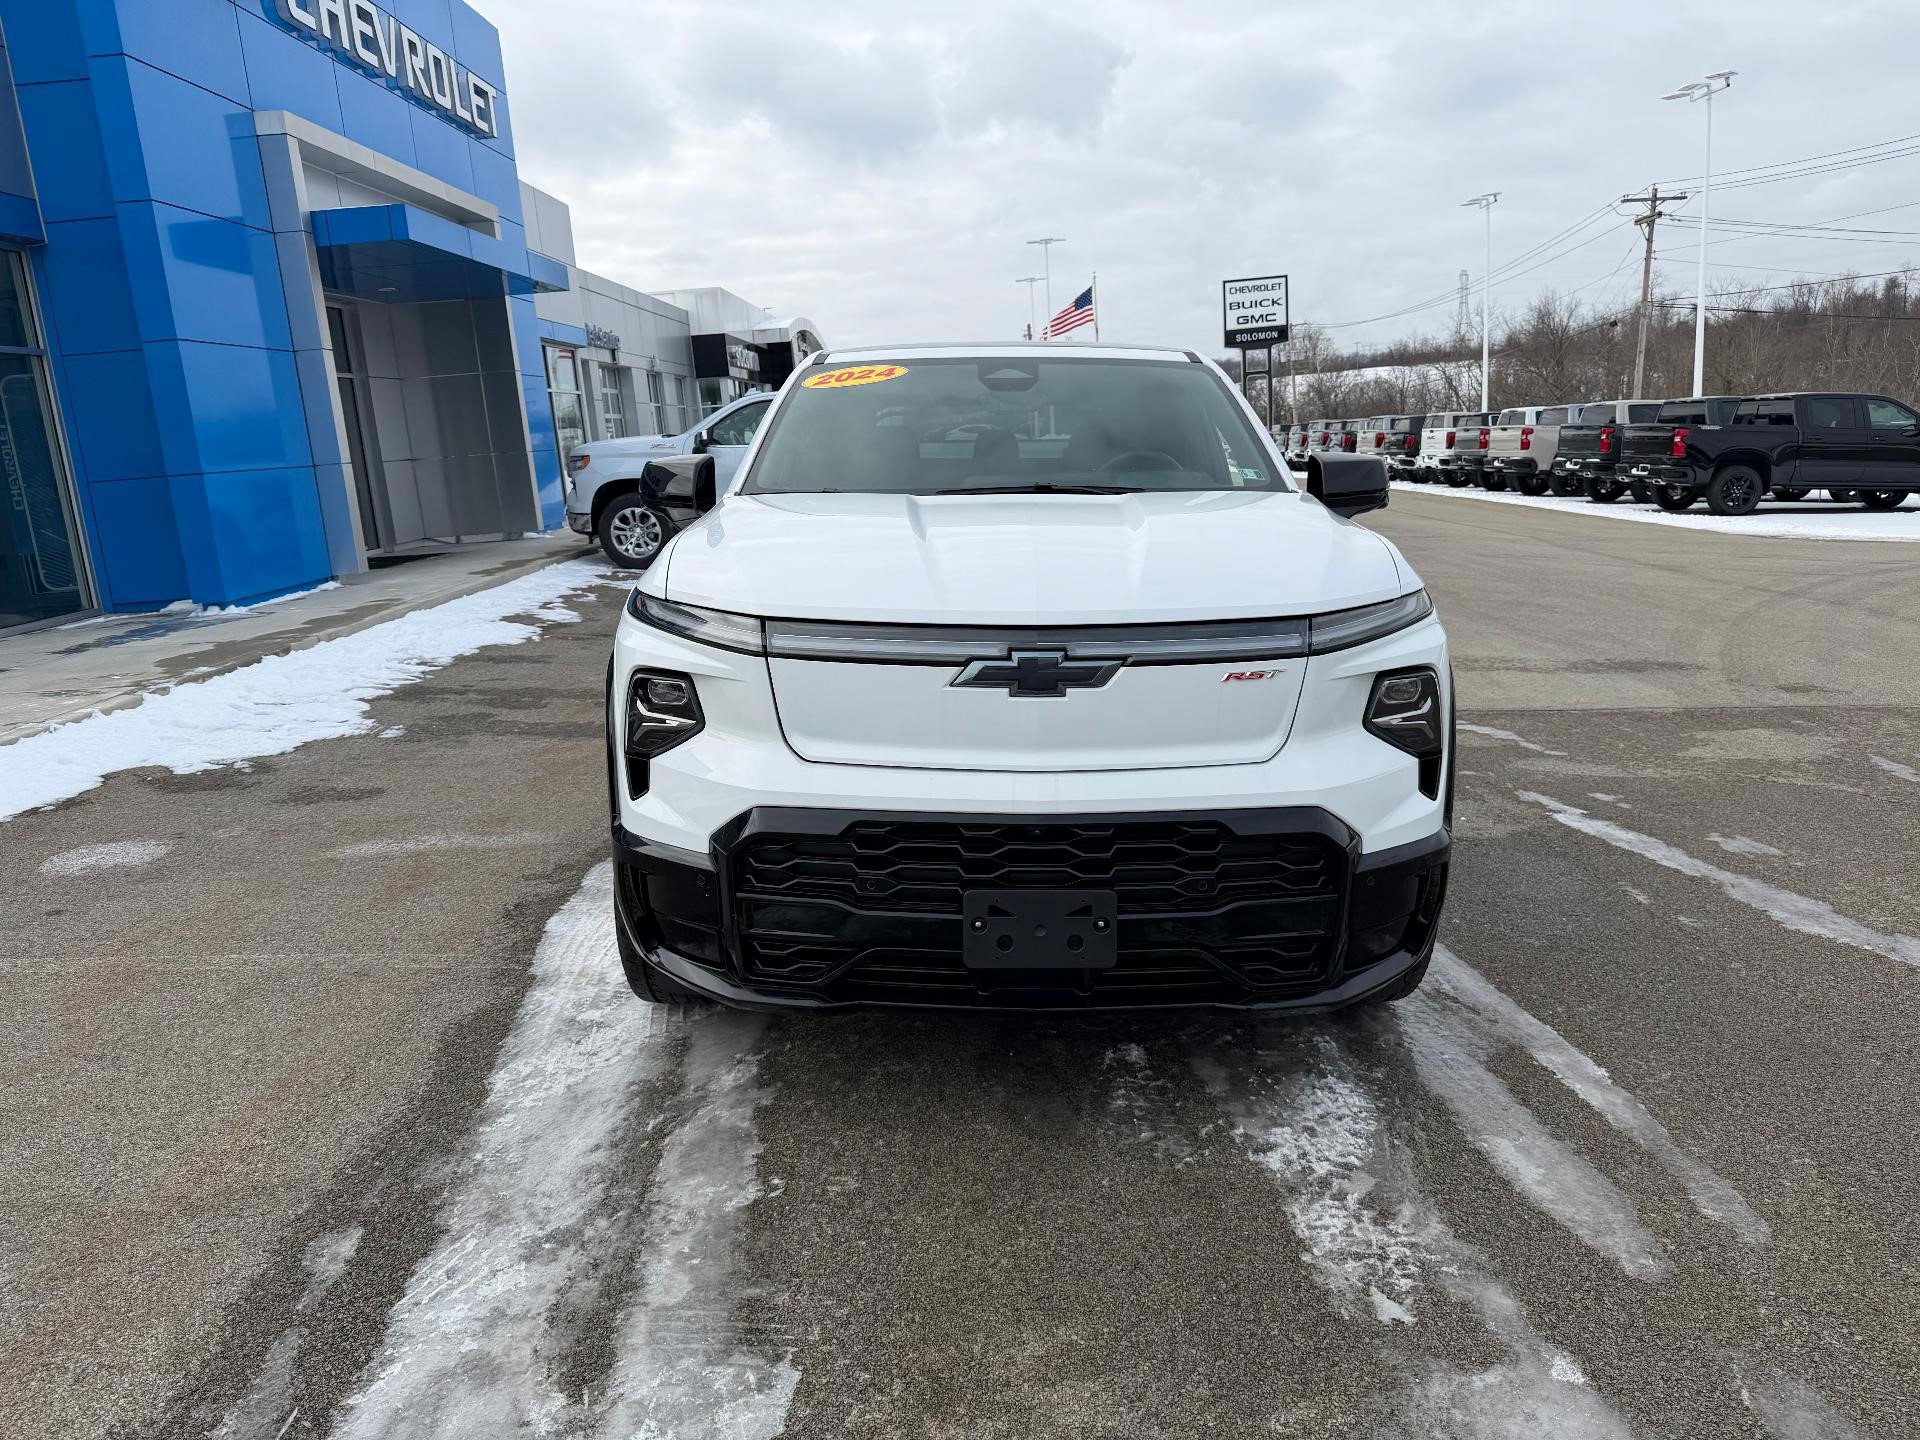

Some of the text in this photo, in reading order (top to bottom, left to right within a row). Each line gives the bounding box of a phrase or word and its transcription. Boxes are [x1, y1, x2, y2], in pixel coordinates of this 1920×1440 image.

[1228, 282, 1284, 295] CHEVROLET
[1228, 297, 1284, 311] BUICK
[1236, 313, 1277, 325] GMC
[1235, 331, 1279, 342] SOLOMON
[811, 367, 897, 387] 2024
[1220, 669, 1287, 682] RST
